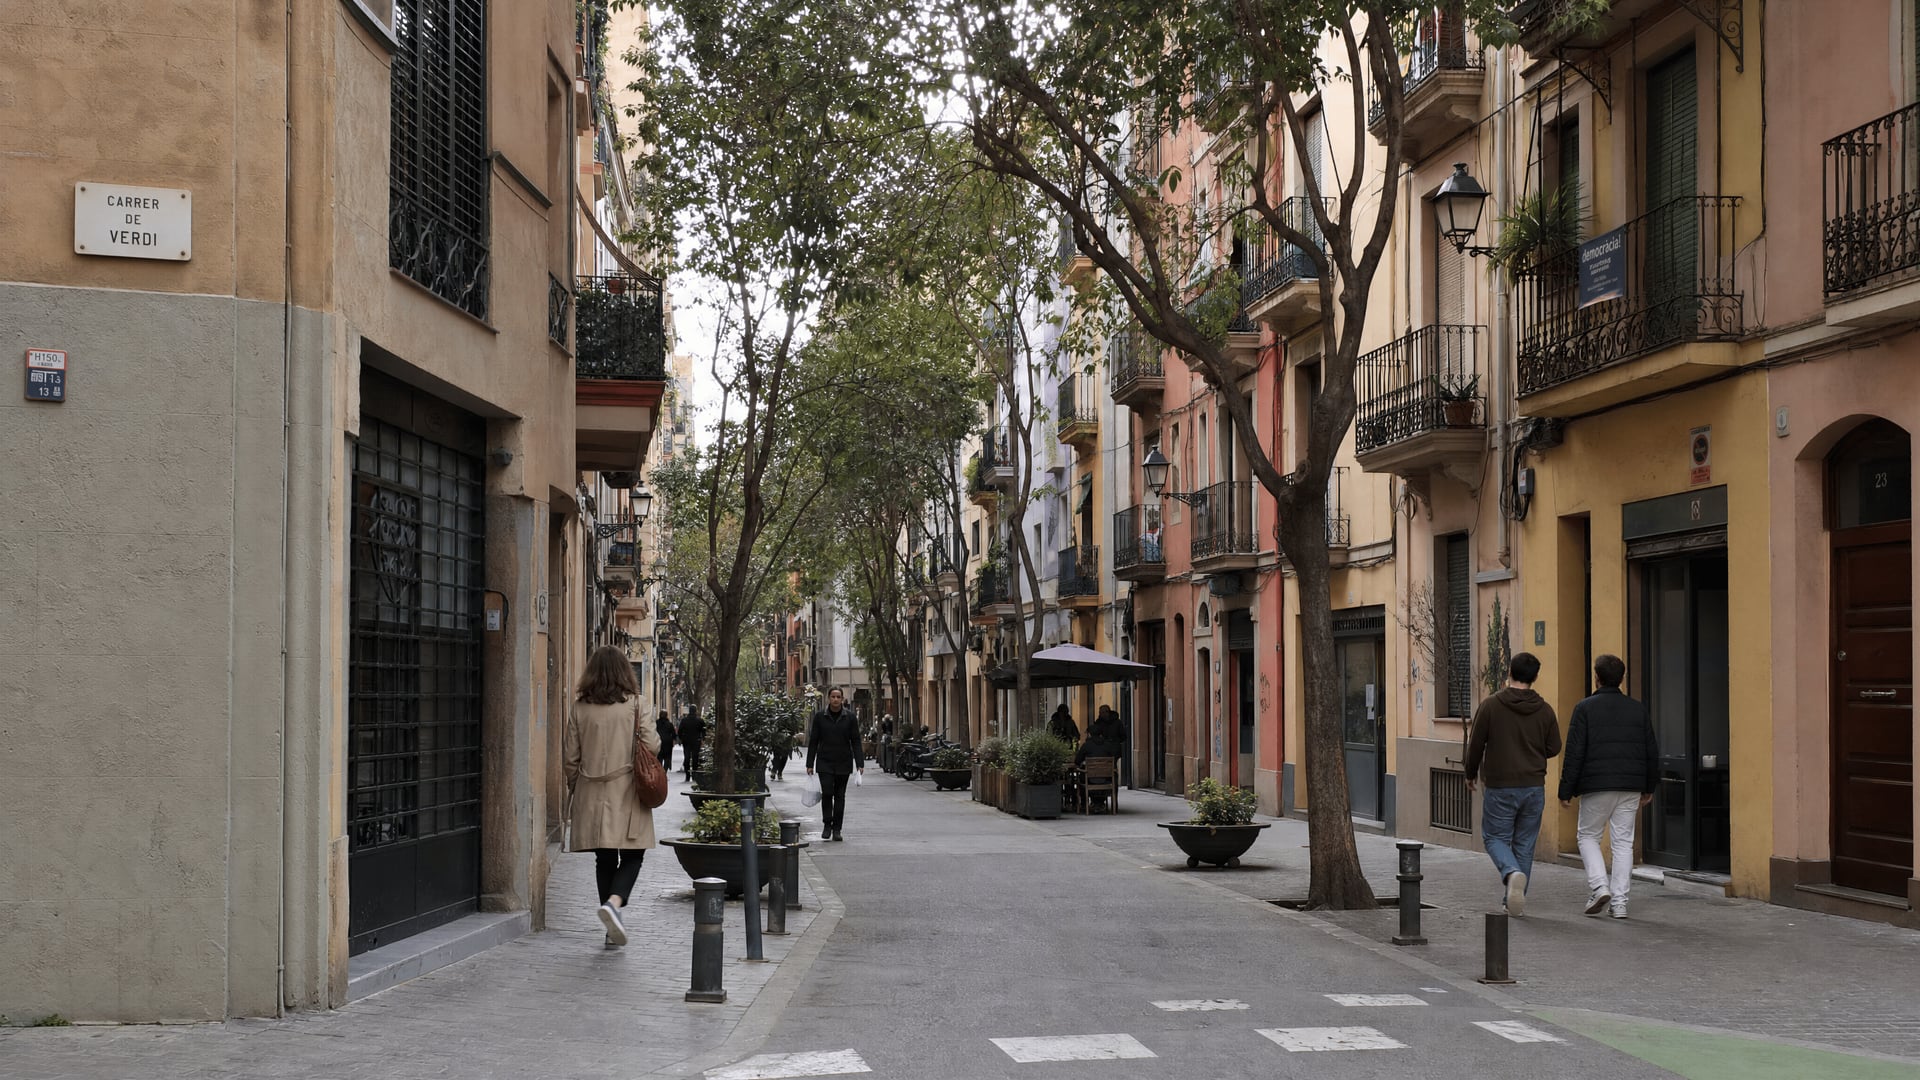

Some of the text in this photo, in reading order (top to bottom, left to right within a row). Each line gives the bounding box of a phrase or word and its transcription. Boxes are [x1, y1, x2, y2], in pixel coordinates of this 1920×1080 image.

[107, 195, 159, 210] CARRER
[125, 213, 141, 225] DE
[110, 229, 157, 247] VERDI
[39, 387, 50, 397] 13
[1875, 472, 1888, 489] 23
